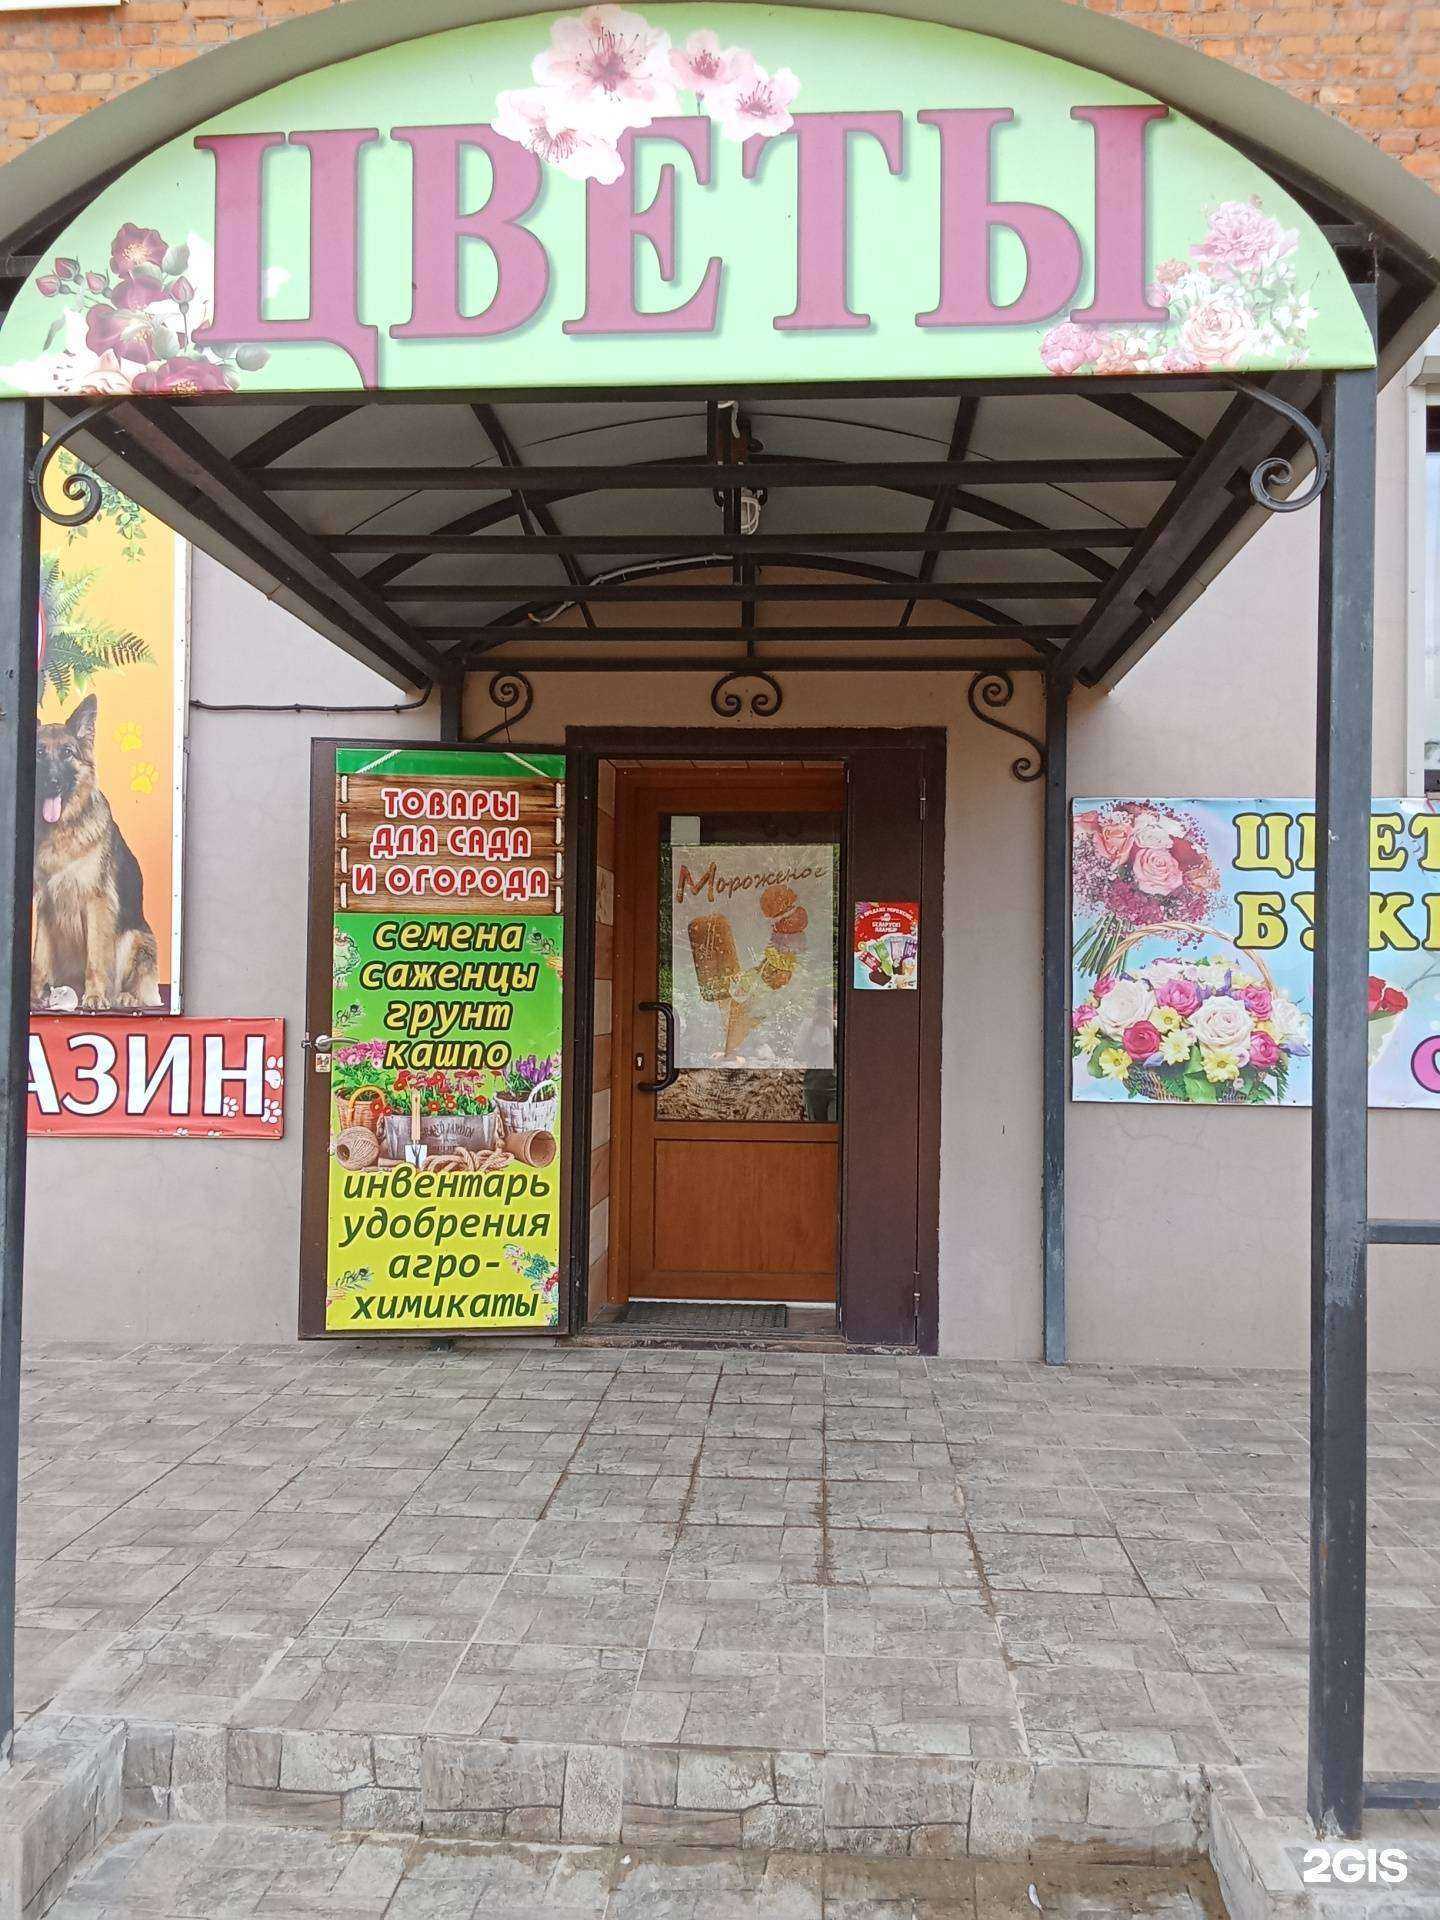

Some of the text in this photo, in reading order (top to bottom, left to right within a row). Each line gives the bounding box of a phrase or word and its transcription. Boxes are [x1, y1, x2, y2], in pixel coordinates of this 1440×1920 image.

[192, 103, 1171, 389] ЦВЕТЫ
[382, 788, 519, 820] ТОВАРЫ
[370, 825, 531, 861] ДЛЯ САДА
[352, 864, 549, 901] И ОГОРОДА
[676, 861, 827, 904] Мороженое
[374, 921, 525, 952] семена
[360, 959, 537, 996] саженцы
[384, 999, 513, 1037] грунт
[383, 1040, 512, 1070] кашпо
[343, 1166, 550, 1205] инвентарь
[338, 1206, 550, 1248] удобрения
[388, 1252, 500, 1286] агро-
[350, 1291, 538, 1320] химикаты
